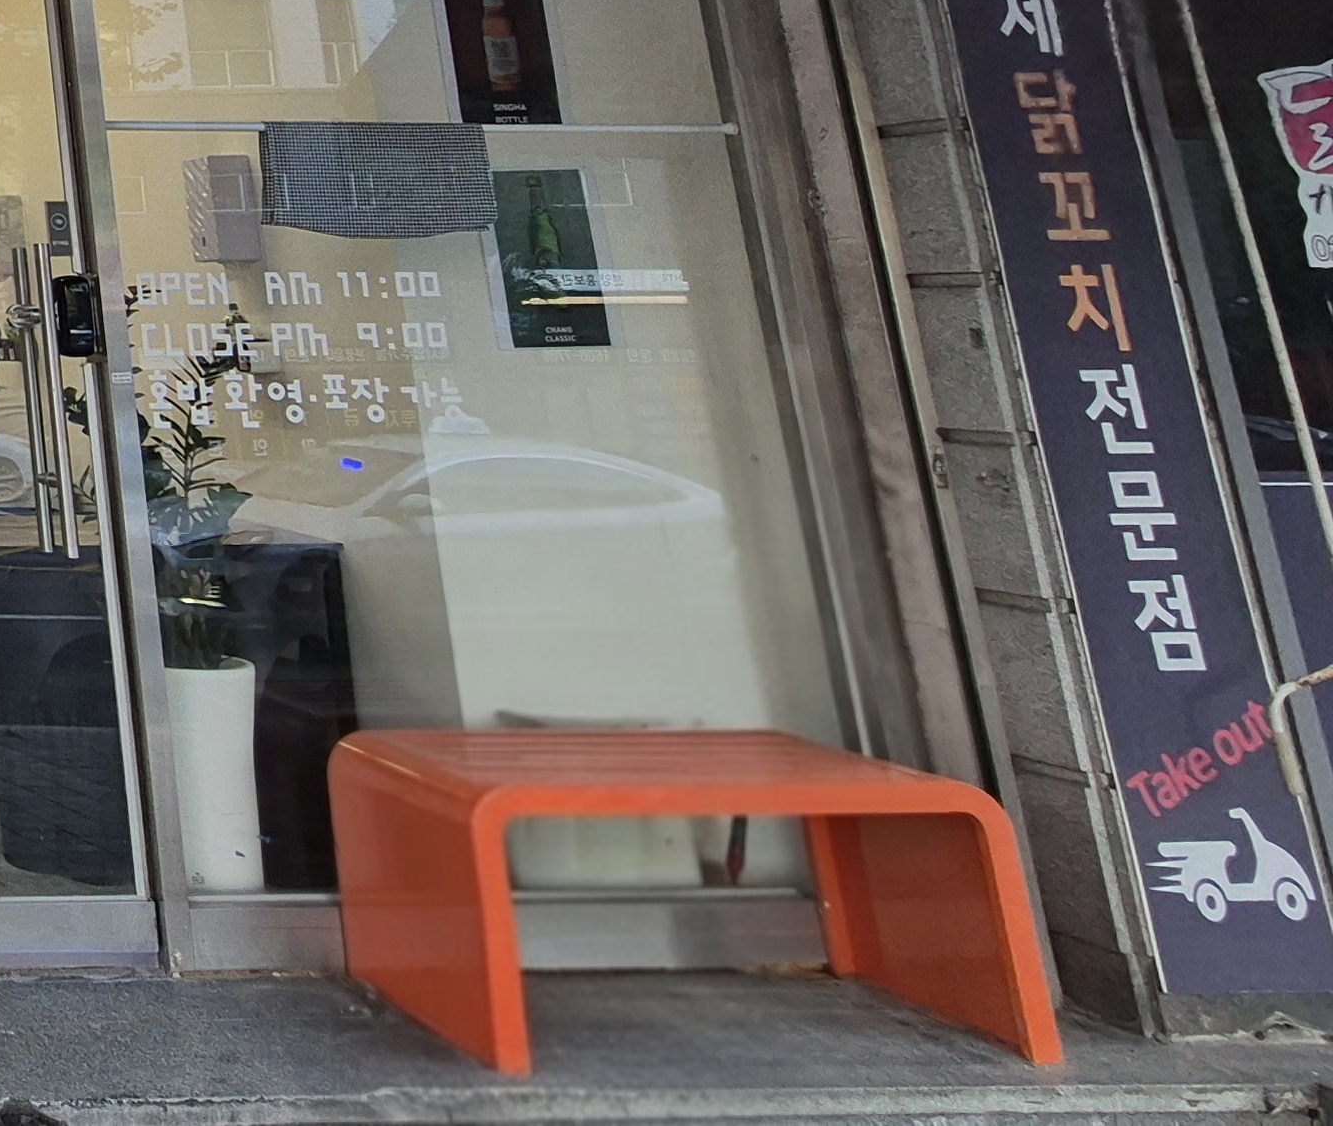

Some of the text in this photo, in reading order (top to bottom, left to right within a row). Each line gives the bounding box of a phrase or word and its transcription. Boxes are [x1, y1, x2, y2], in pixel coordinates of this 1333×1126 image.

[493, 103, 527, 112] SINGHA
[495, 115, 529, 124] BOTTLE
[136, 271, 230, 306] OPEN
[336, 270, 442, 299] 11:00
[141, 322, 256, 360] CLOSE
[356, 322, 451, 350] 9:00
[545, 326, 573, 334] CHANG
[545, 335, 576, 343] CLASSIC
[401, 377, 464, 423] 가능
[1126, 700, 1274, 818] Take out
